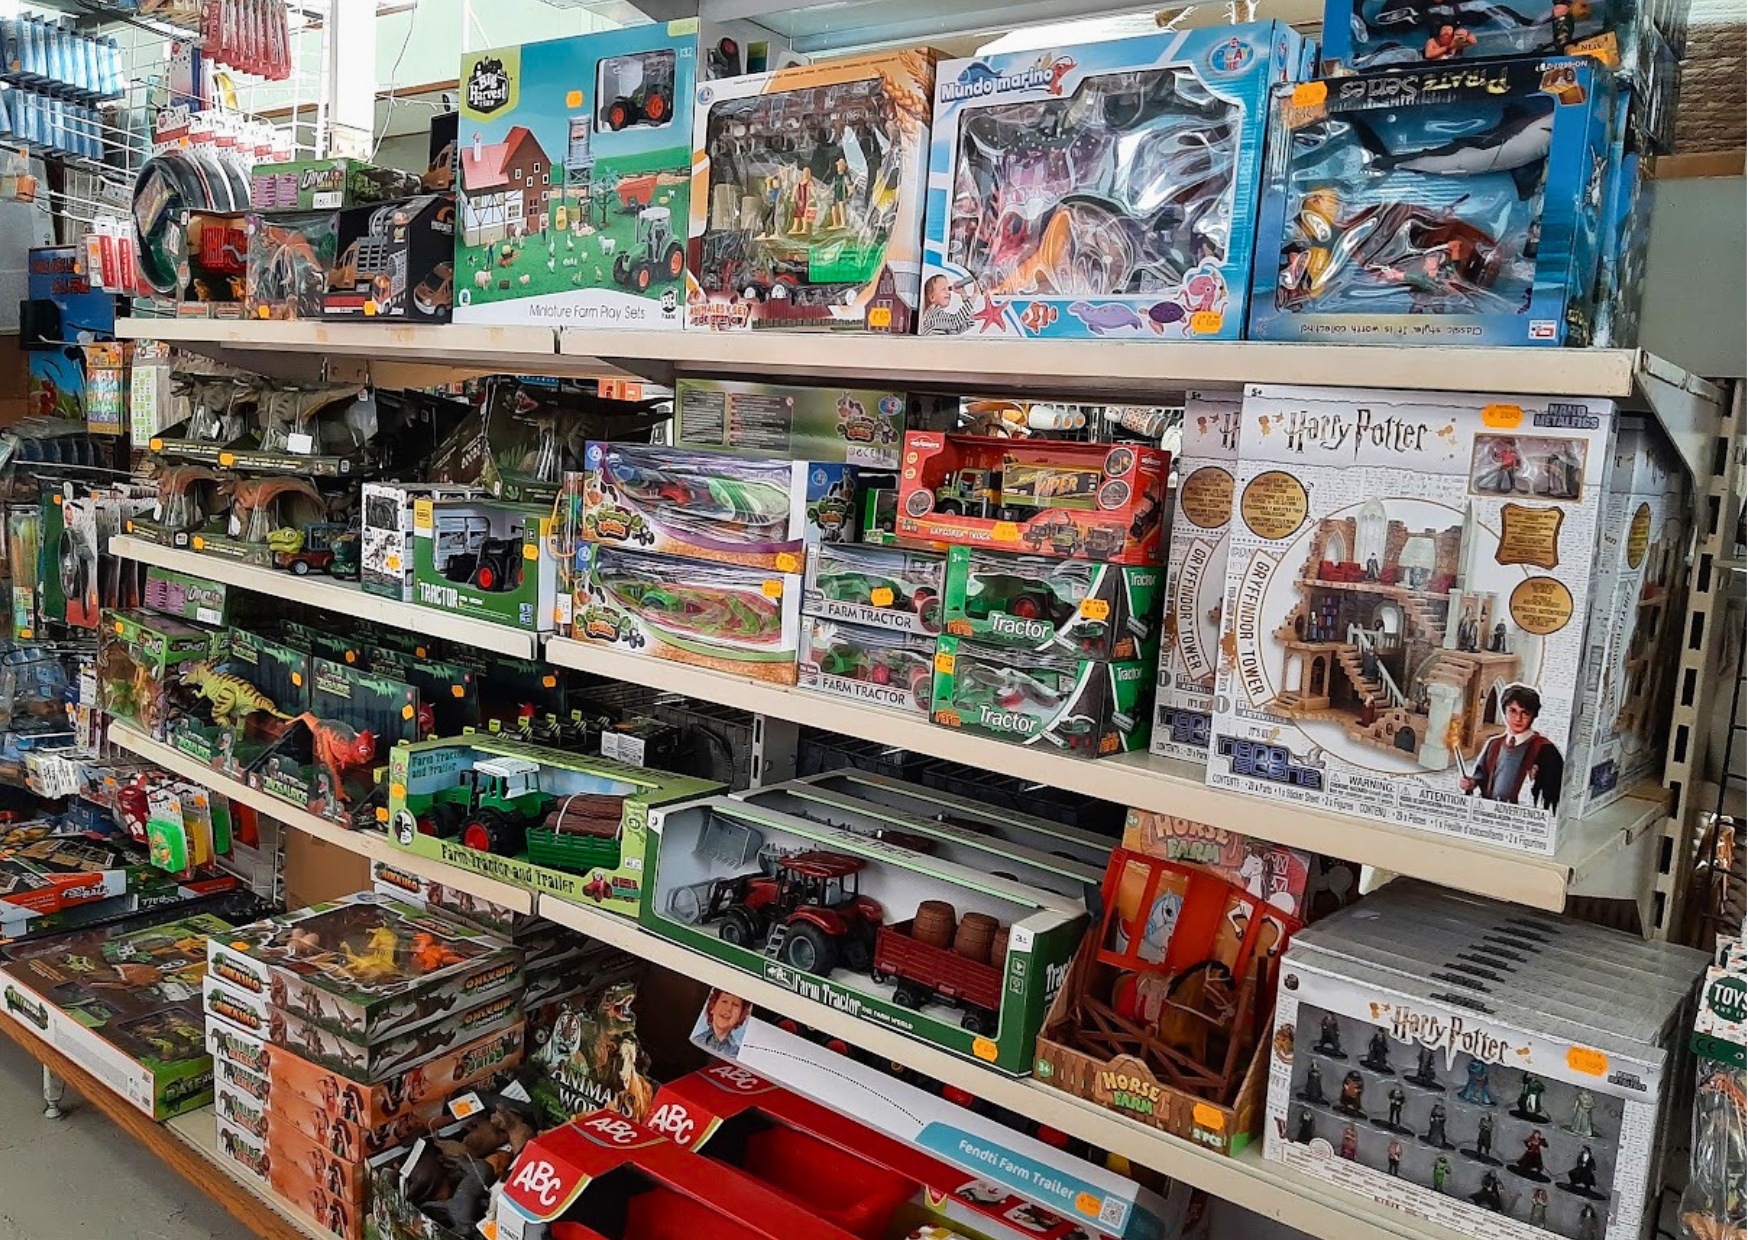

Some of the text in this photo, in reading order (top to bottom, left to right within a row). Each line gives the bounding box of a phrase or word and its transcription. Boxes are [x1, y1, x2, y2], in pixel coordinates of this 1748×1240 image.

[941, 65, 1054, 103] Mundo marino
[529, 304, 646, 321] Miniature Farm Play Sets
[1284, 410, 1352, 454] Harry
[1354, 408, 1430, 461] Potter
[951, 552, 963, 563] 3+
[420, 582, 459, 608] TRACTOR
[828, 604, 911, 629] FARM TRACTOR
[1179, 548, 1206, 671] GRYFFINDOR TOWER
[990, 612, 1051, 640] Tractor
[1239, 561, 1270, 697] GRYFFINDOR TOWER
[822, 677, 906, 706] FARM TRACTOR
[979, 705, 1038, 733] Tractor
[412, 751, 433, 767] Farm
[412, 762, 457, 779] and Trailer
[1349, 776, 1394, 793] WARNING:
[1334, 798, 1354, 813] Figures
[1167, 837, 1220, 864] FARM
[441, 843, 470, 864] Farm
[536, 870, 575, 894] Trailer
[795, 973, 820, 1002] Farm
[823, 983, 862, 1016] Tractor
[1391, 1005, 1447, 1050] Harry
[1449, 1015, 1514, 1064] Potter
[709, 1064, 759, 1090] ABC
[1102, 1071, 1161, 1102] HORSE
[1112, 1091, 1153, 1115] FARM
[584, 1117, 638, 1144] ABC
[648, 1103, 694, 1145] ABC
[1202, 1131, 1222, 1148] PCS
[512, 1160, 562, 1207] ABC
[958, 1139, 1076, 1200] Fendti Farm Trailer
